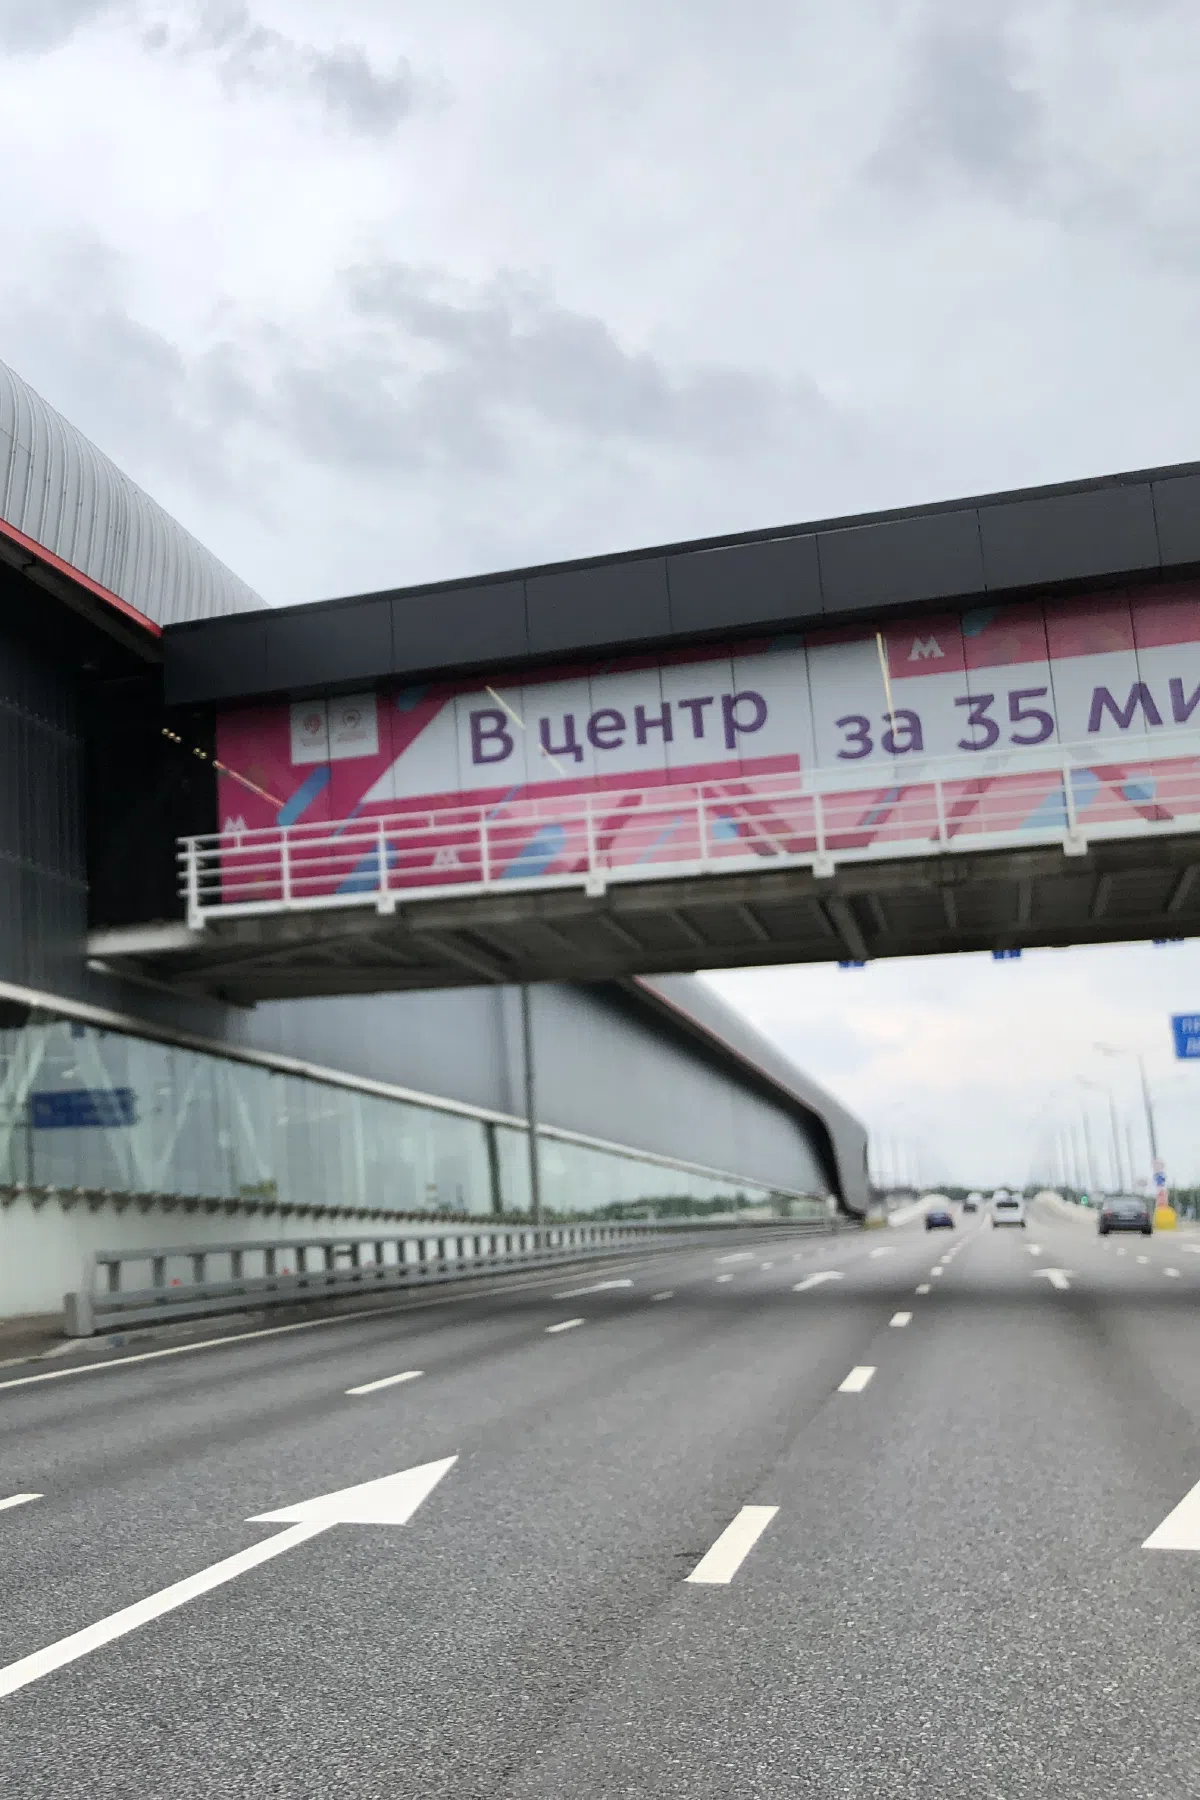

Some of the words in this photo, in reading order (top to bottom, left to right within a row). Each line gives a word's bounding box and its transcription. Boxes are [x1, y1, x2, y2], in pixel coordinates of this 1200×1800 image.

[470, 708, 514, 765] В
[539, 689, 768, 763] центр
[835, 707, 924, 759] за
[954, 686, 1055, 751] 35
